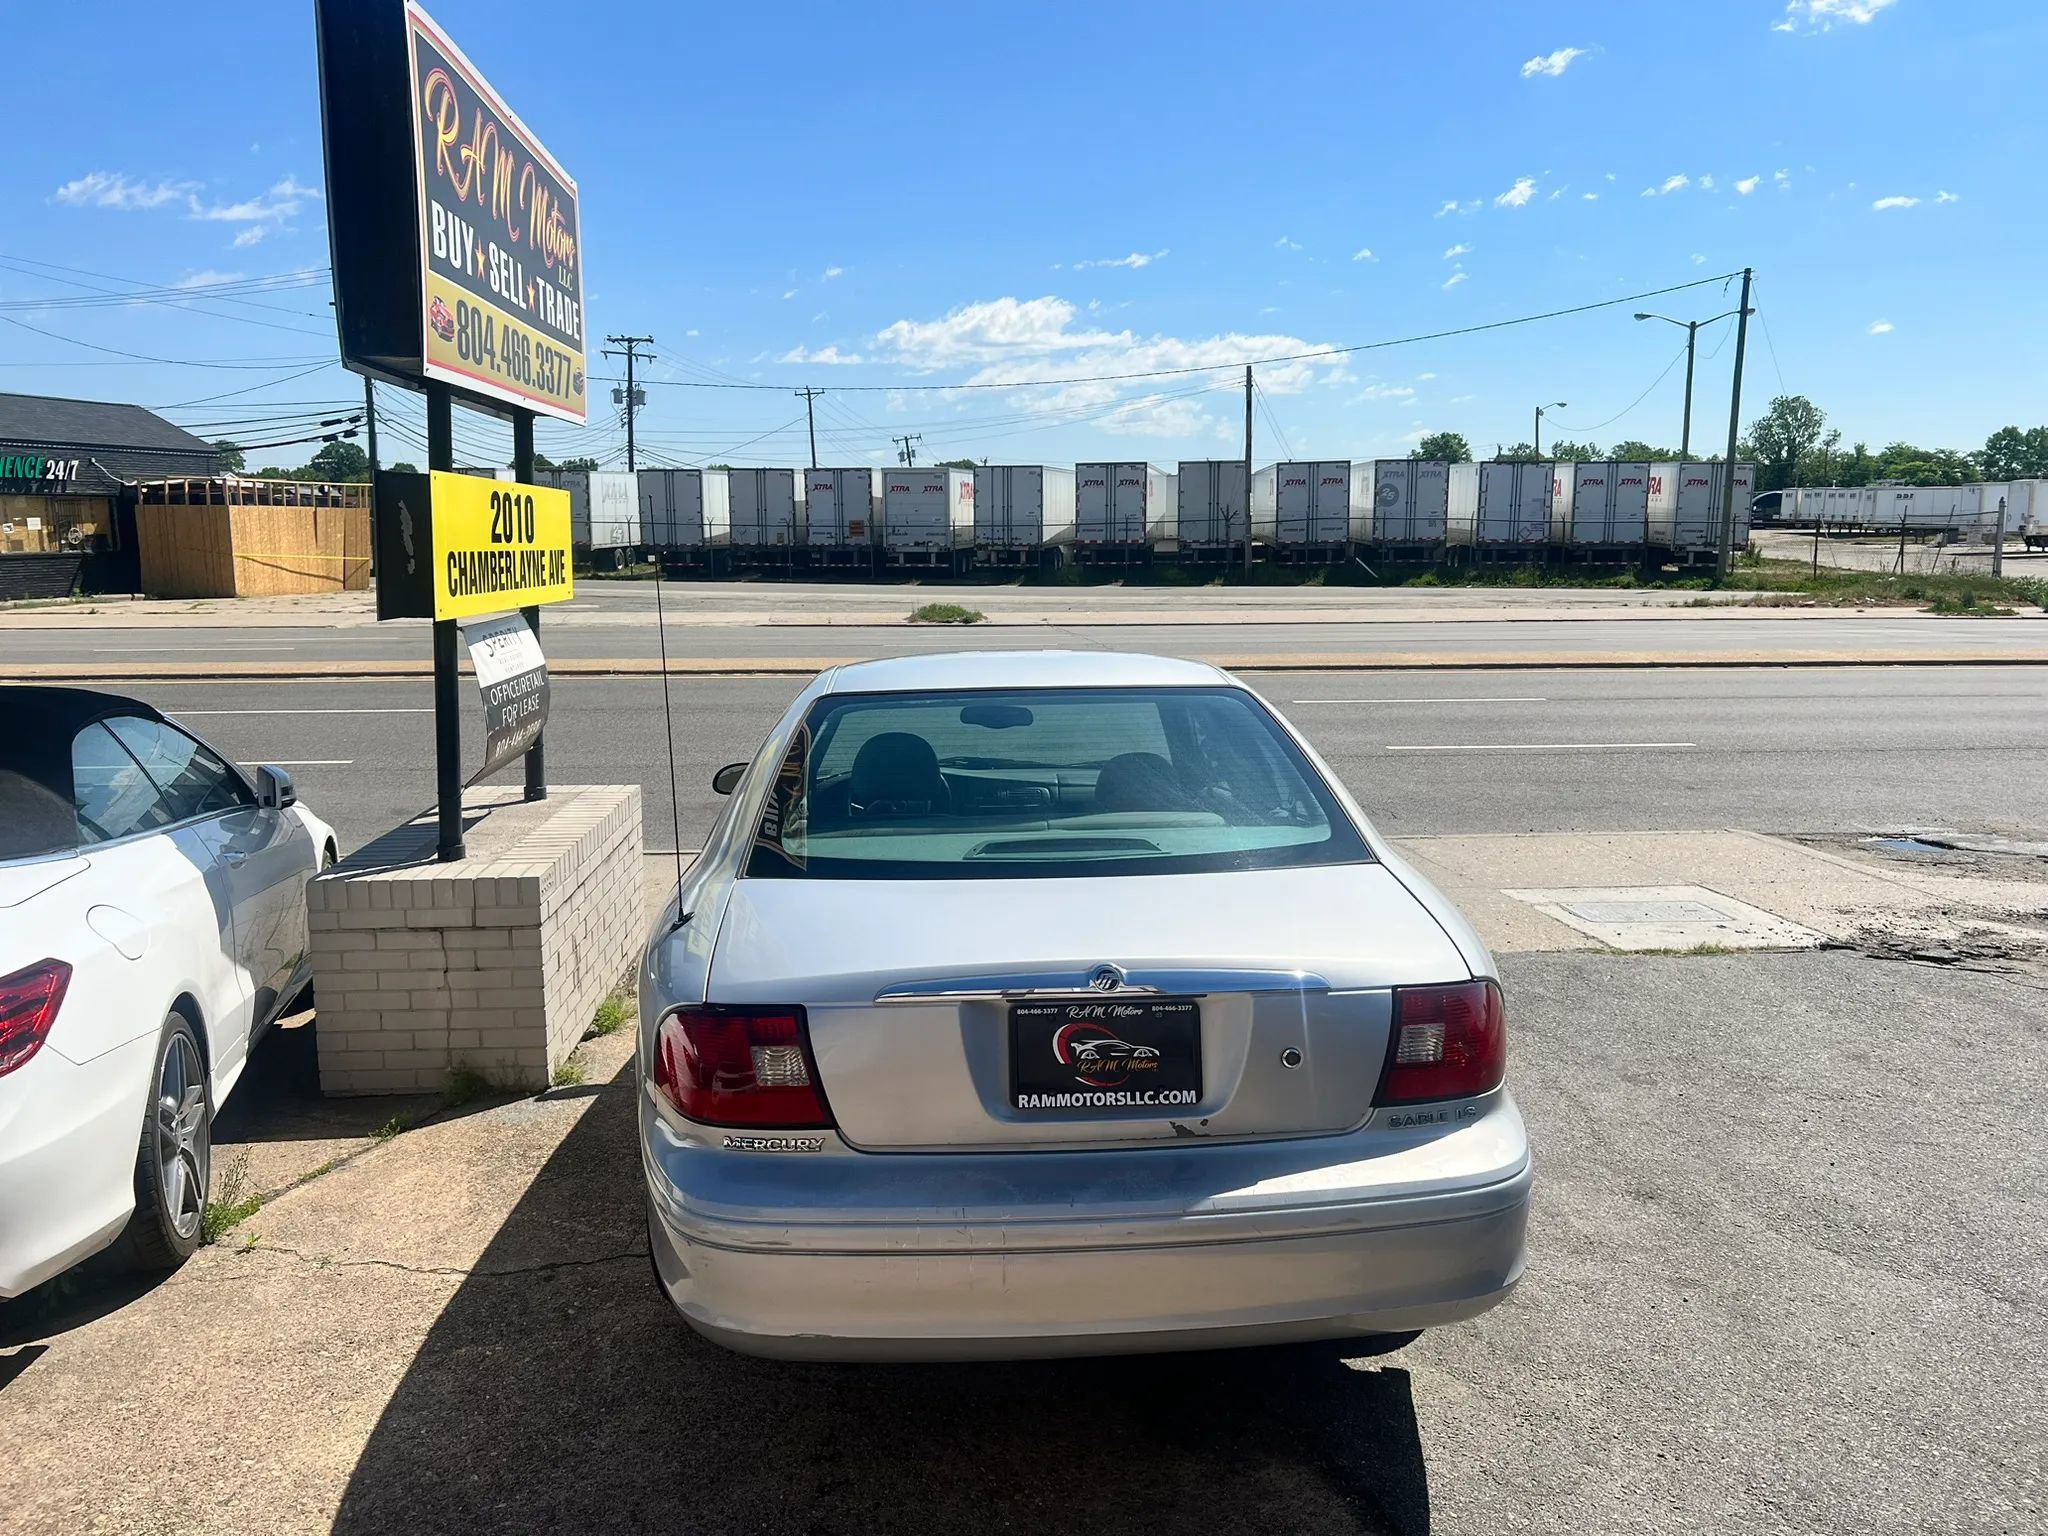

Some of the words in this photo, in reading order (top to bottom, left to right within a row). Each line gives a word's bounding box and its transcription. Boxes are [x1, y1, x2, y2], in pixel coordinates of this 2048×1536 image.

[424, 67, 520, 243] RAM
[520, 161, 577, 269] Motors
[431, 199, 477, 277] BUY
[488, 241, 528, 311] SELL
[536, 276, 582, 341] TRADE
[558, 265, 573, 291] LLC
[456, 299, 572, 400] 804.466.3377
[46, 459, 79, 481] 24/7
[812, 483, 833, 492] XTRA
[889, 485, 911, 493] XTRA
[922, 485, 944, 494] XTRA
[1082, 479, 1105, 488] XTRA
[1117, 478, 1140, 488] XTRA
[1283, 478, 1306, 488] XTRA
[1320, 477, 1344, 487] XTRA
[1581, 478, 1604, 487] XTRA
[1618, 478, 1642, 487] XTRA
[1685, 478, 1709, 487] XTRA
[490, 490, 535, 544] 2010
[447, 551, 546, 598] CHAMBERLAYNE
[548, 549, 566, 585] AVE
[490, 670, 545, 706] OFFICE/RETAIL
[502, 704, 518, 728] FOR
[519, 693, 540, 717] LEASE
[1016, 1007, 1058, 1015] 804-466-3377
[1066, 1005, 1107, 1019] RAM
[1108, 1005, 1143, 1018] Motors
[1151, 1004, 1193, 1012] 804-466-3377
[1121, 1057, 1159, 1071] Motors
[1388, 1110, 1449, 1129] SABLE
[722, 1135, 826, 1152] MERCURY
